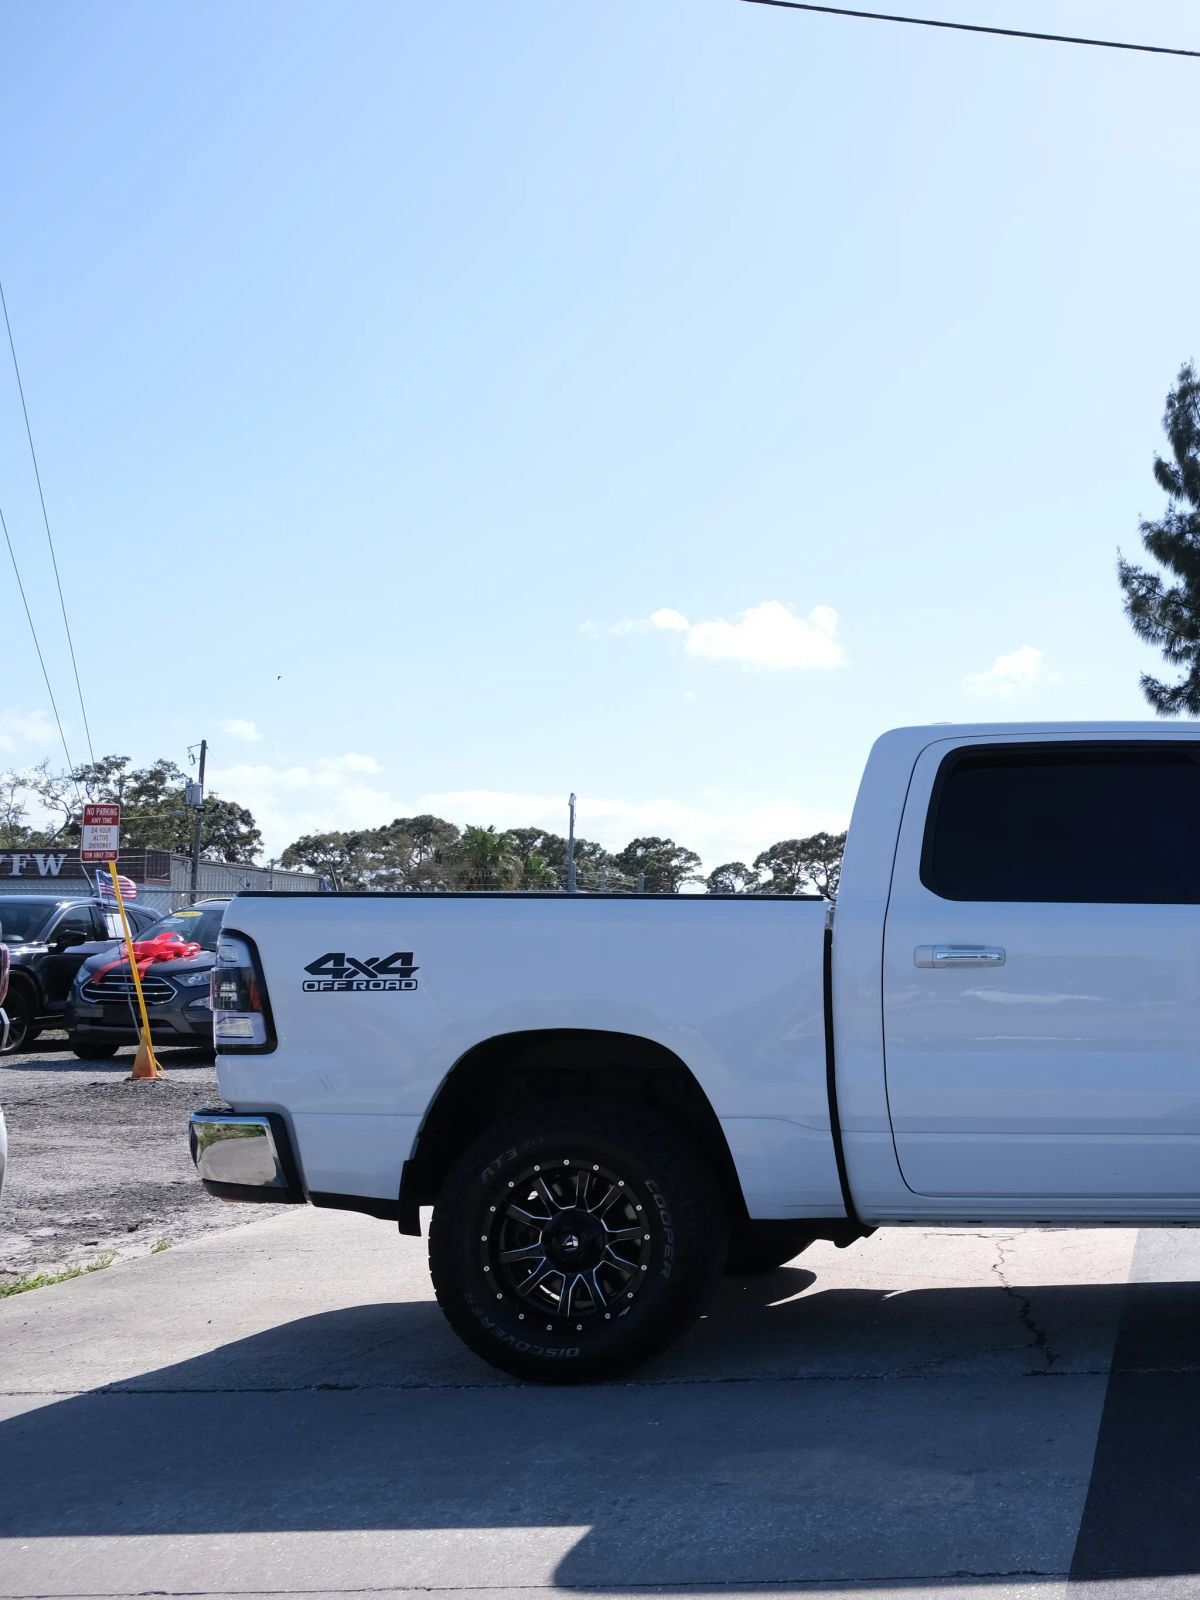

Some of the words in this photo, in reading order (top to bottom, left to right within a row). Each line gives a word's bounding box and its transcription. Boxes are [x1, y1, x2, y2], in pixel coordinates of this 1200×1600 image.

[86, 807, 94, 816] NO
[95, 807, 118, 816] PARKING
[303, 981, 347, 991] OFF
[352, 980, 417, 990] ROAD
[644, 1179, 674, 1280] COOPER
